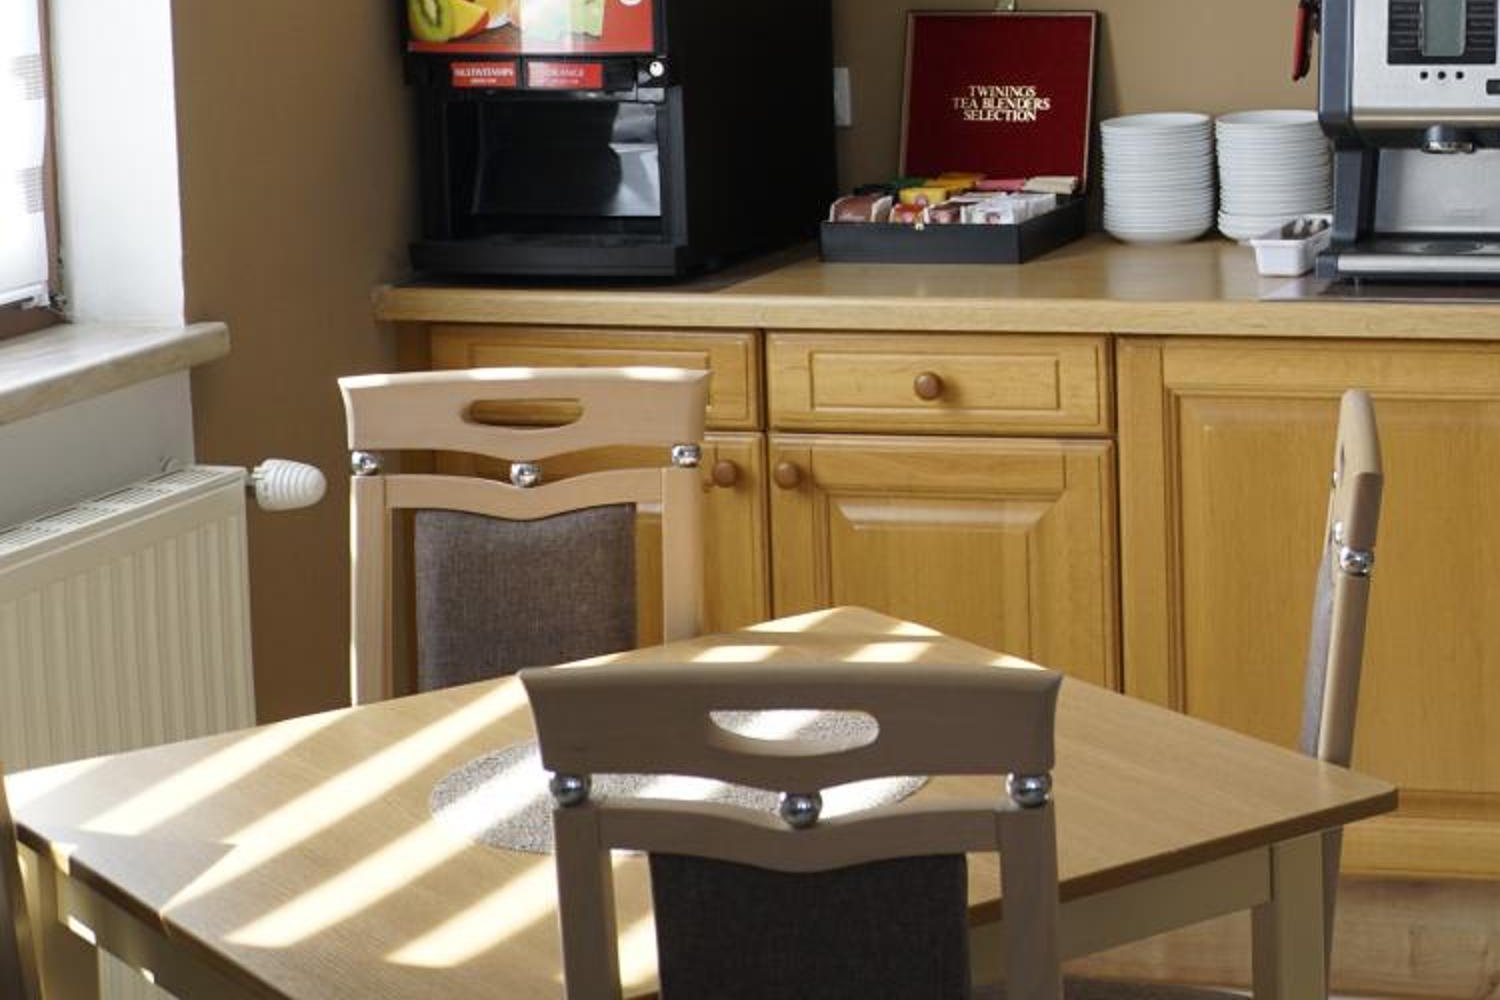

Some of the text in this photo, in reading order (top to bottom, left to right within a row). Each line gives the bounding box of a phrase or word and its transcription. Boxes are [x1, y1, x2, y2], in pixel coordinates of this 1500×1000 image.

[968, 85, 1037, 97] TWININGS
[952, 97, 1051, 111] TEA BLENDERS
[962, 109, 1037, 121] SELECTION
